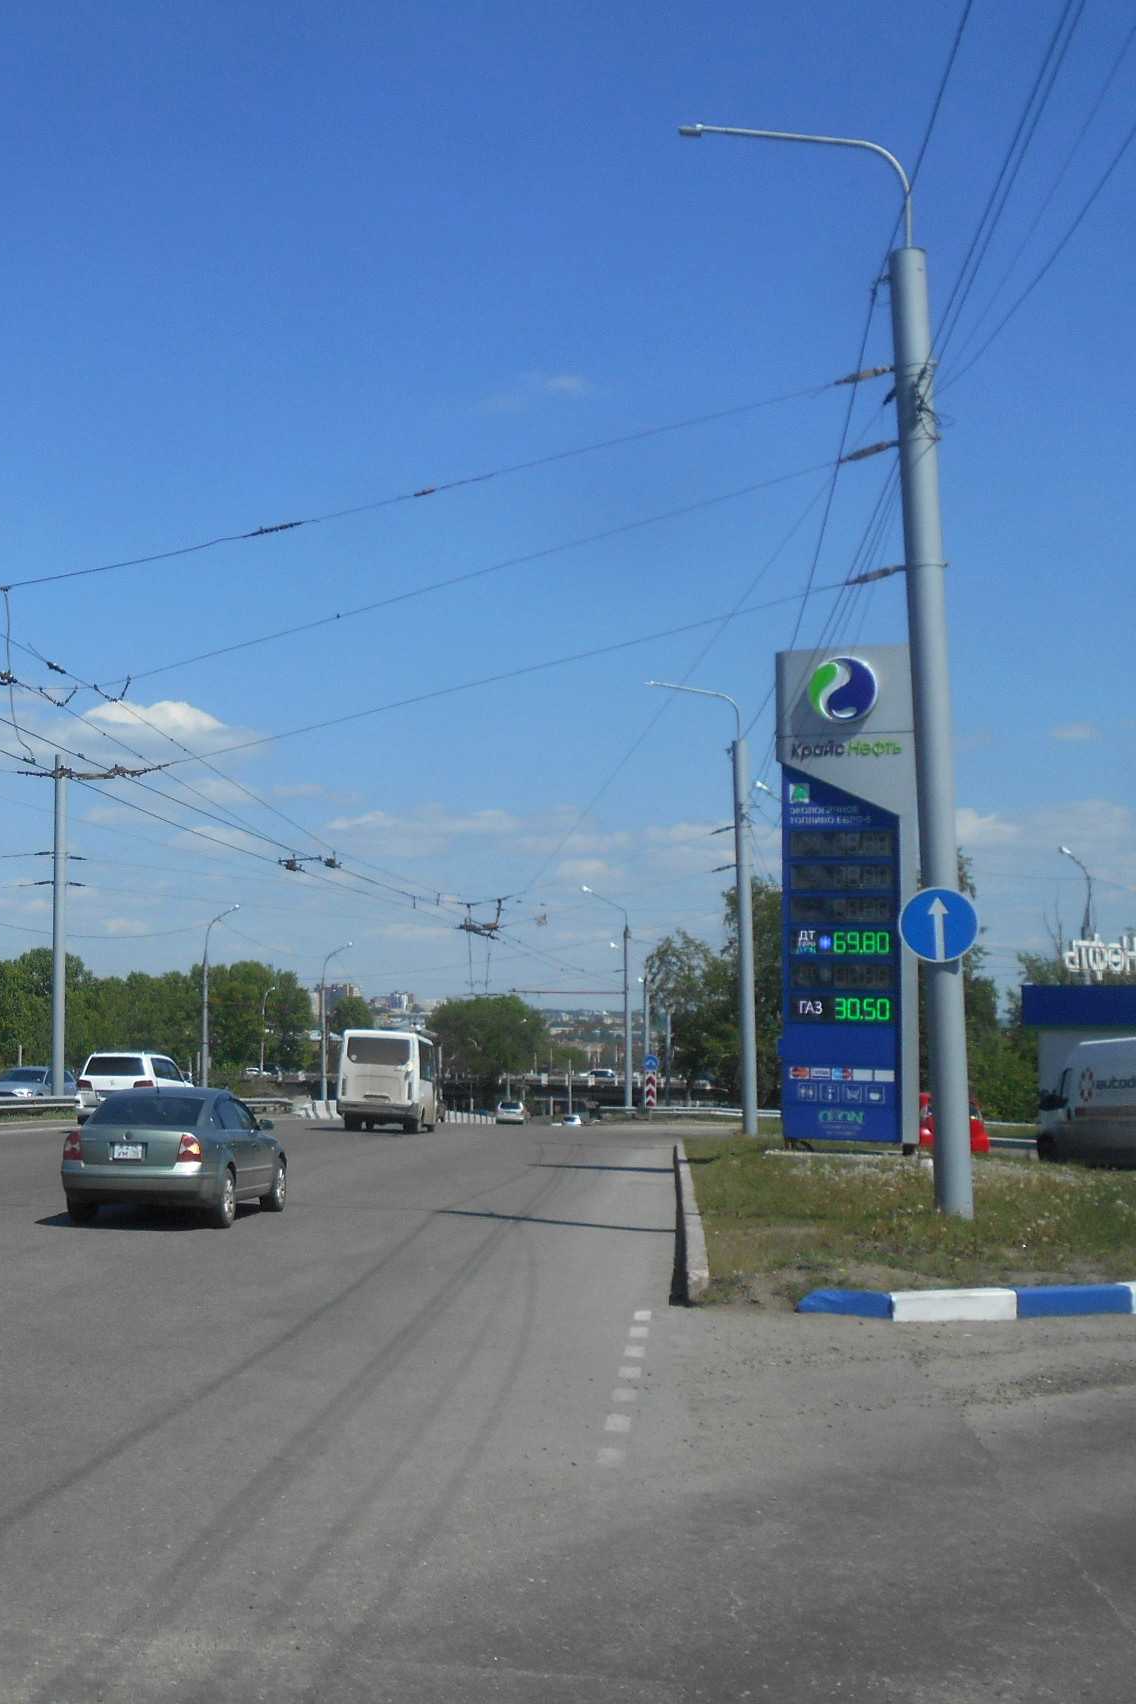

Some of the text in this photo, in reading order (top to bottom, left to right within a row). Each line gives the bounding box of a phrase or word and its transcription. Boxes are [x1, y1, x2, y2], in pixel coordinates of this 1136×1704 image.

[790, 740, 903, 762] Крайс Нефть
[798, 930, 816, 941] ДТ
[799, 1000, 823, 1015] ГАЗ
